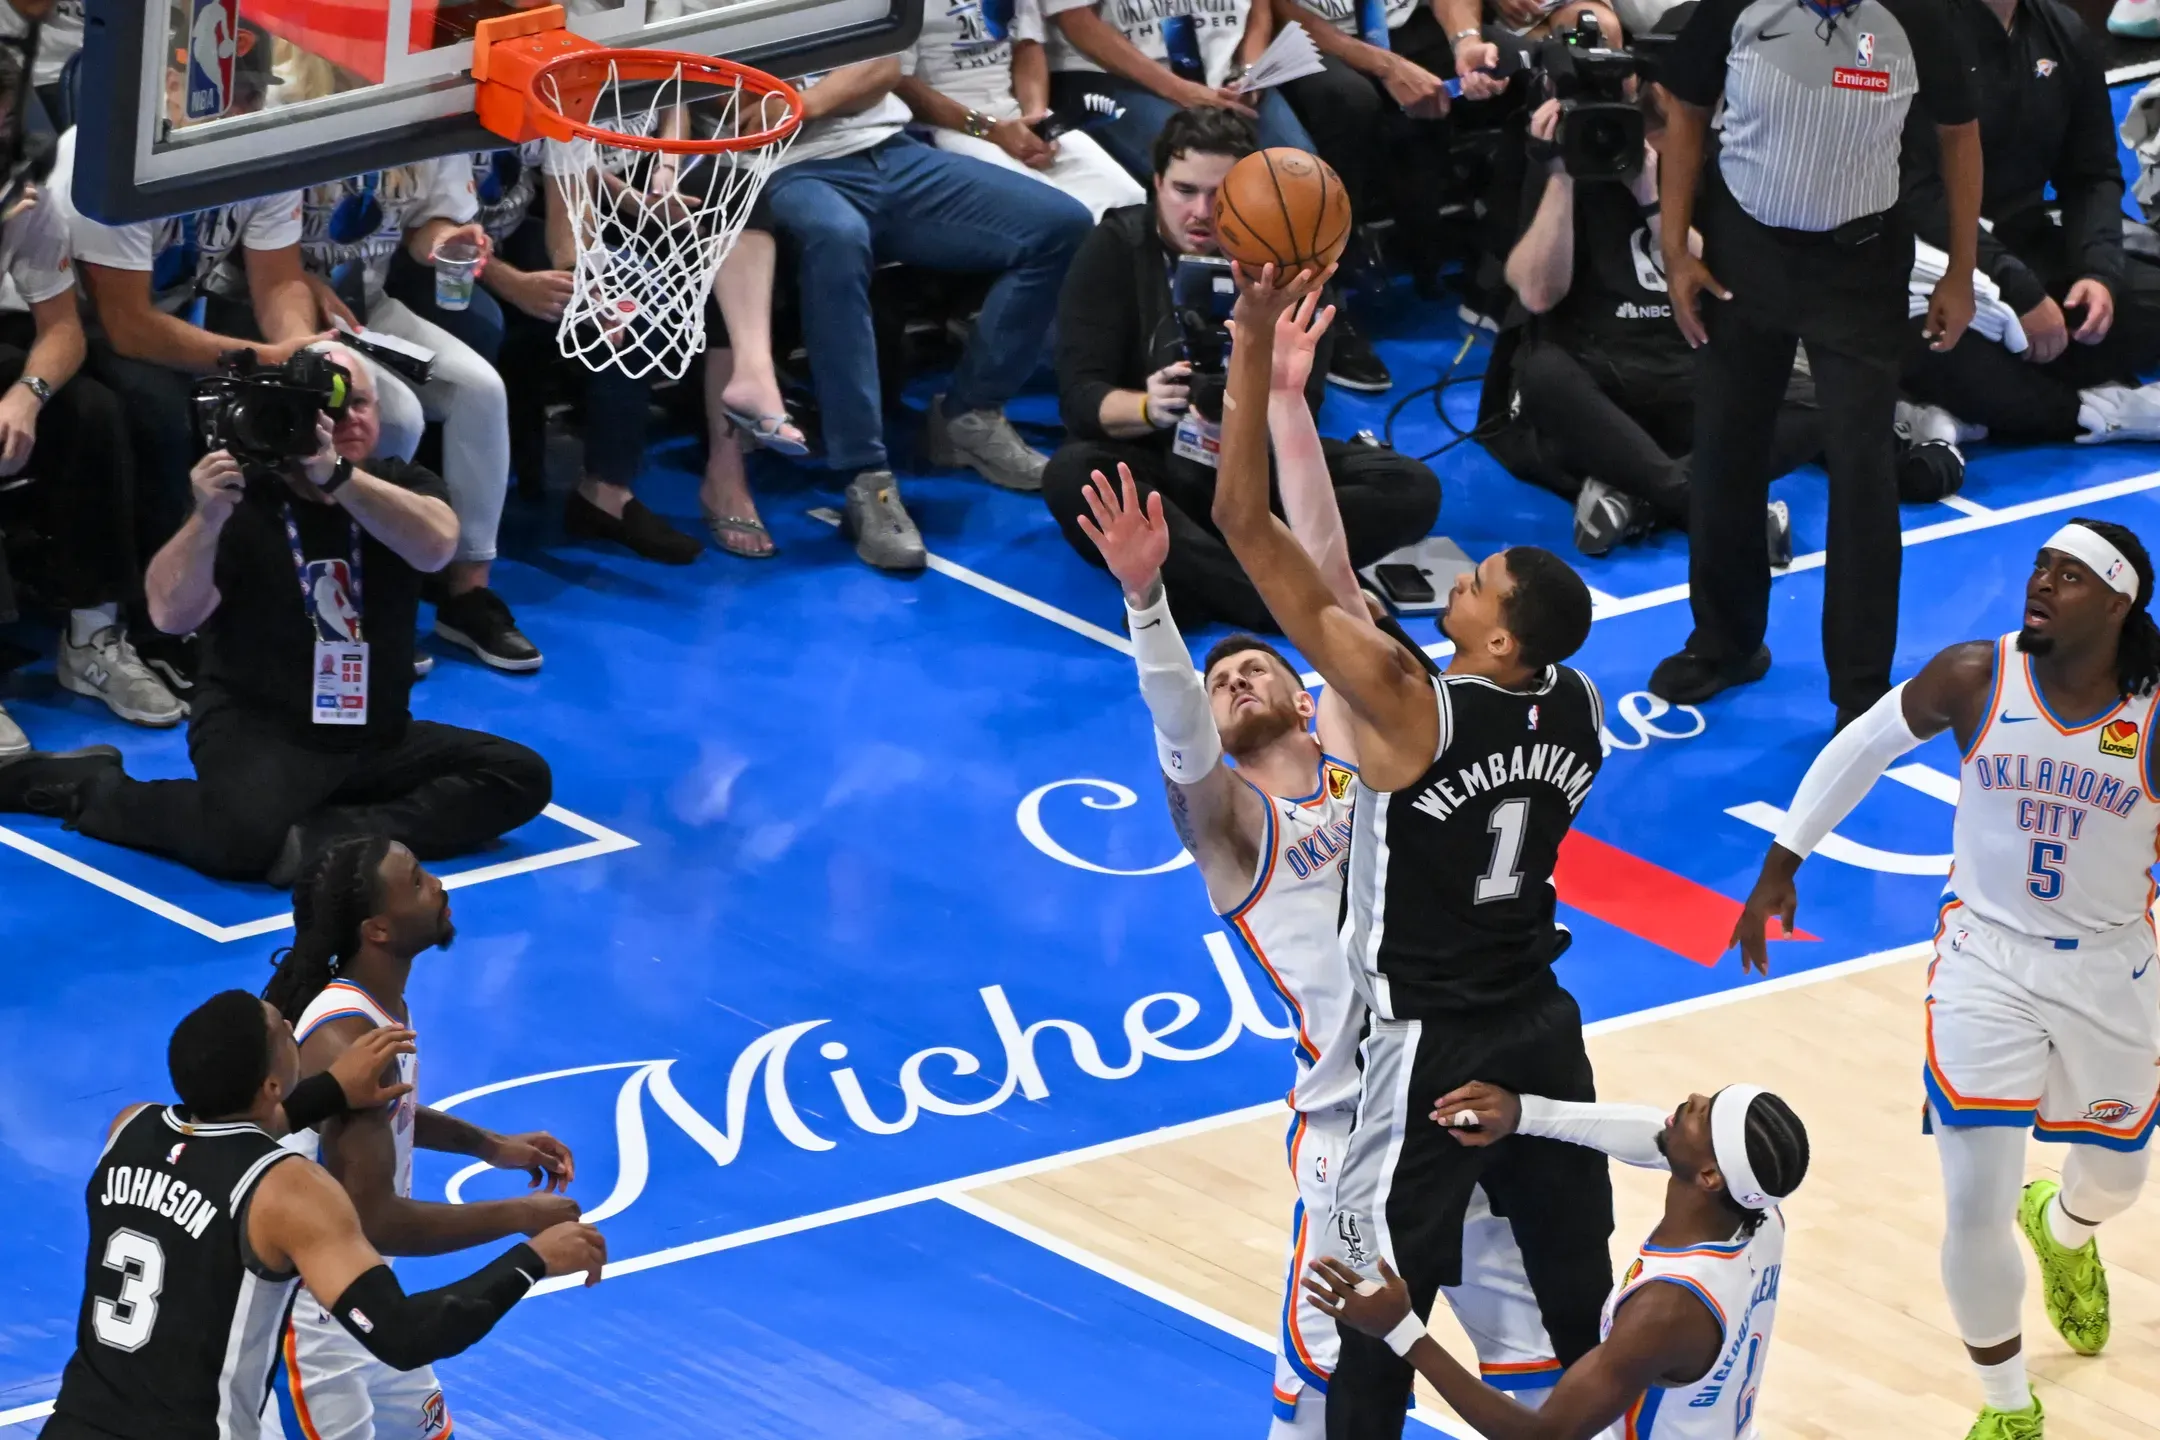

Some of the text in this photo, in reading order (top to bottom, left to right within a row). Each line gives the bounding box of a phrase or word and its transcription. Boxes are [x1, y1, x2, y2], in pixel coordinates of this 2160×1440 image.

[1123, 16, 1238, 40] THDER
[191, 88, 215, 112] NBA
[1834, 71, 1888, 88] Emirates
[1638, 305, 1672, 318] NBC
[1975, 754, 2143, 819] OKLAHOMA
[2017, 797, 2088, 840] CITY
[1473, 797, 1531, 905] 1
[2026, 838, 2068, 901] 5
[426, 931, 1298, 1223] Michel
[101, 1166, 218, 1239] JOHNSON
[92, 1226, 166, 1353] 3
